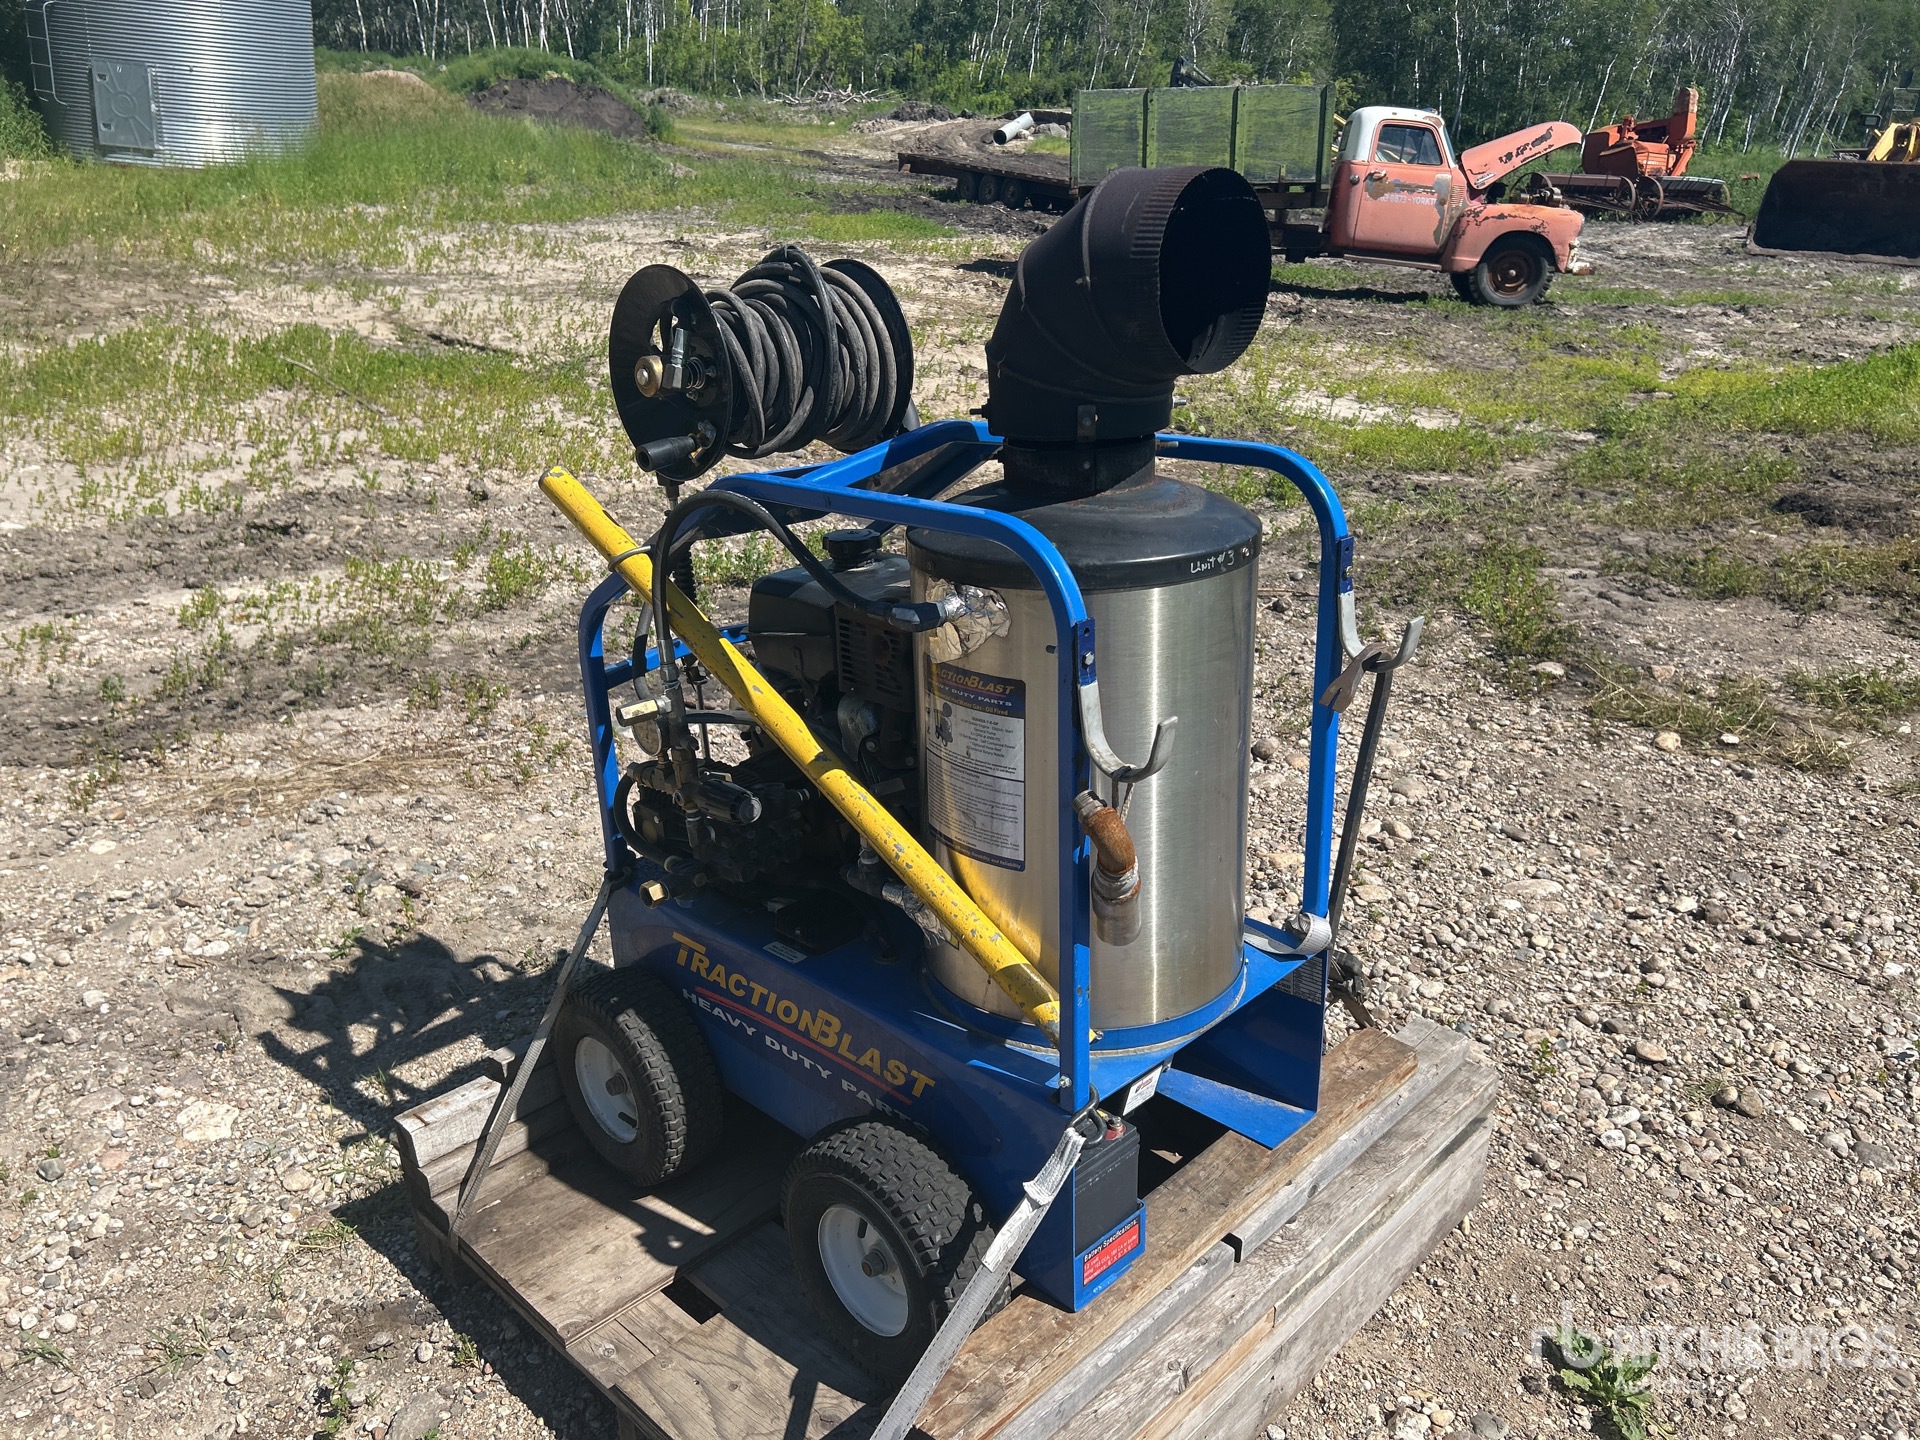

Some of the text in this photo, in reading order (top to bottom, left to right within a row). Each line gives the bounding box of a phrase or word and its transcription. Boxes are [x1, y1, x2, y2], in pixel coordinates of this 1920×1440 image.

[951, 688, 976, 699] DUTY
[978, 696, 1012, 707] PARTS
[994, 708, 1009, 716] Fired
[683, 988, 757, 1037] HEAVY
[765, 1035, 832, 1080] DUTY
[1084, 1244, 1103, 1263] Battery
